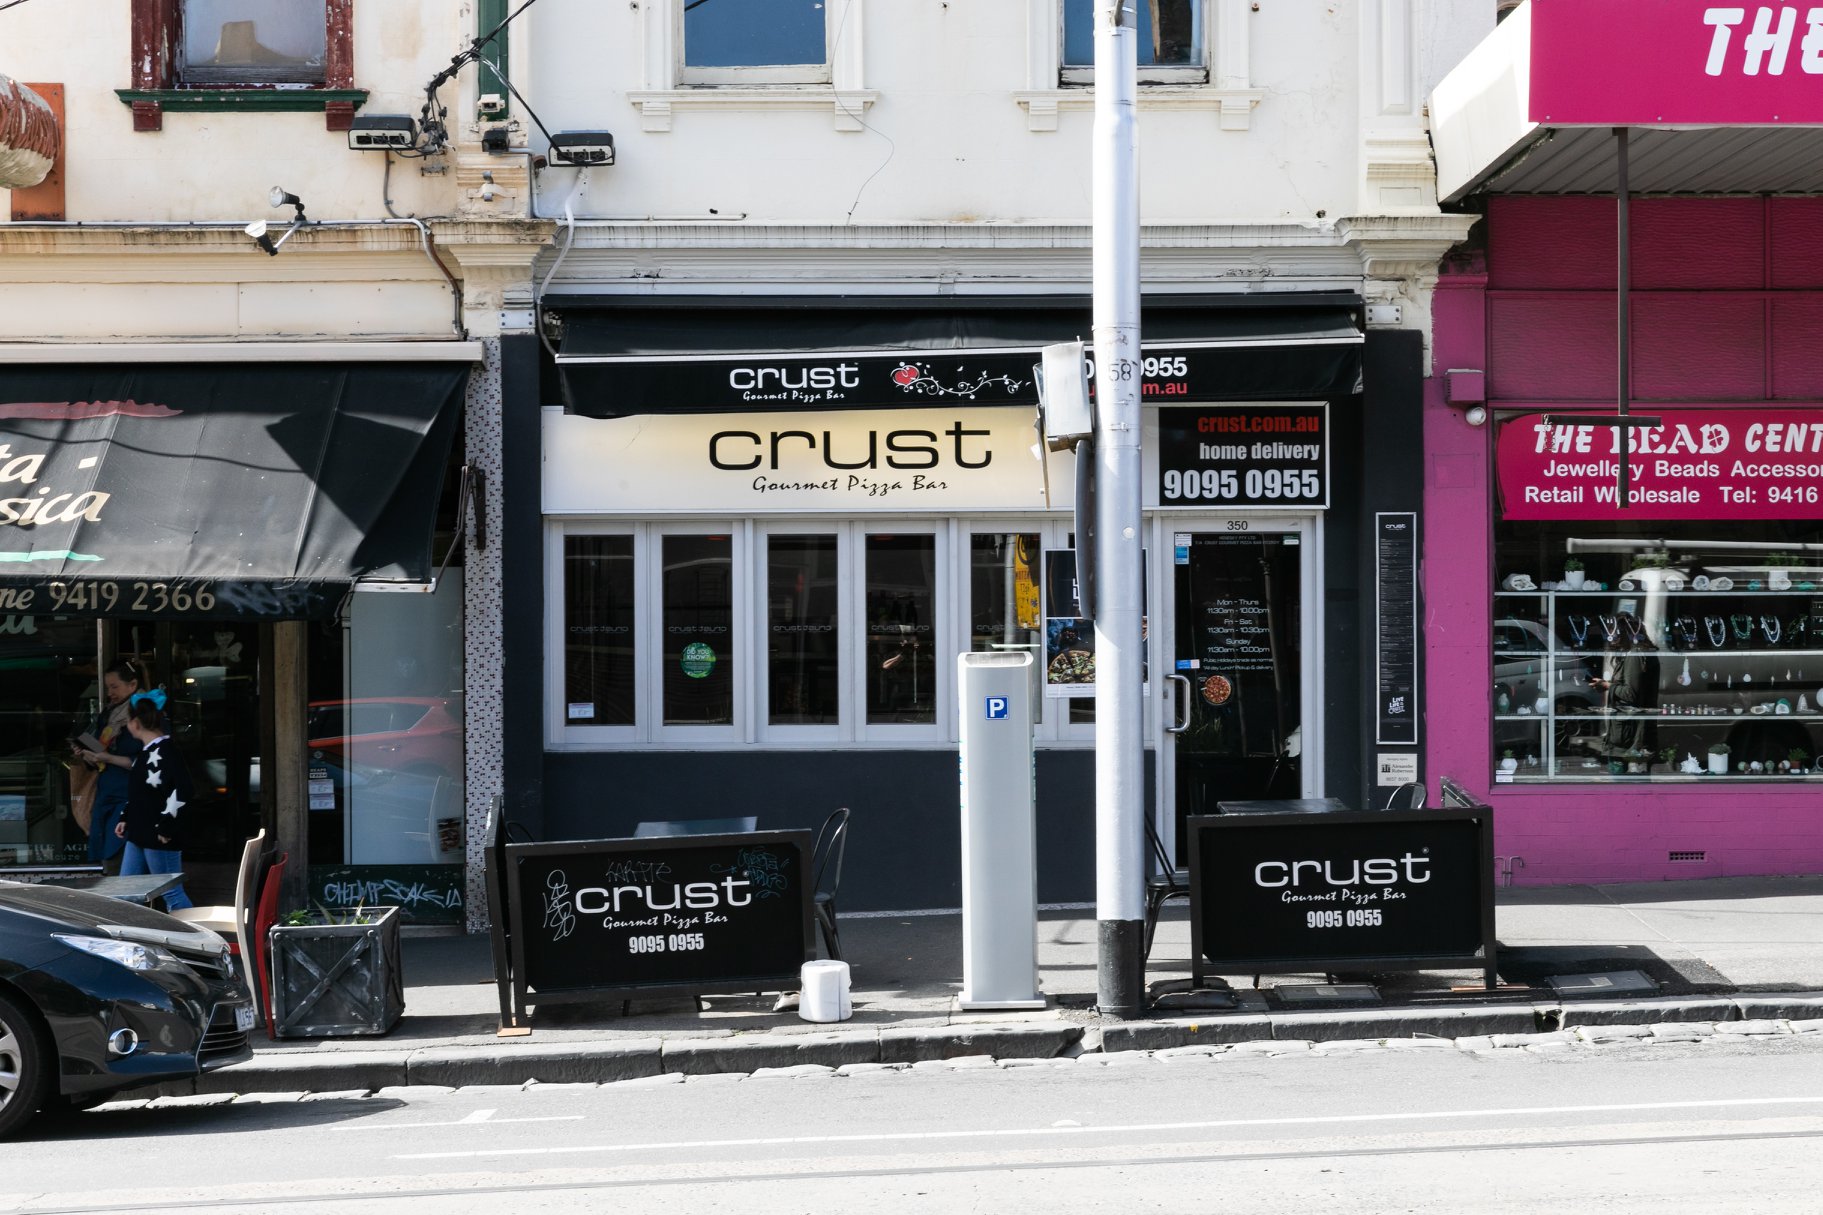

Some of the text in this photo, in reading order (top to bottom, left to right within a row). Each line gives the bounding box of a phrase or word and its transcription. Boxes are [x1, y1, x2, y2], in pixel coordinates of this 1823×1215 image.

[1703, 7, 1823, 76] THE
[729, 363, 859, 389] crust
[1109, 362, 1131, 382] 58
[1140, 357, 1187, 378] 955
[743, 390, 845, 402] Gourmet Pizza Bar
[1197, 414, 1319, 433] crust.com.au
[708, 421, 992, 470] crust
[1533, 424, 1594, 453] THE
[1609, 423, 1730, 454] BEAD
[1199, 442, 1320, 461] home delivery
[1543, 460, 1644, 481] Jewelley
[1655, 460, 1720, 478] Beads
[752, 474, 949, 496] Gourmet Pizza Bar
[1163, 469, 1319, 499] 9095 0955
[1525, 486, 1584, 503] Retail
[1719, 486, 1757, 504] Tel:
[1767, 486, 1819, 504] 9416
[1227, 520, 1248, 530] 350
[49, 581, 119, 612] 9419
[131, 581, 215, 612] 2366
[990, 698, 1004, 716] P
[1255, 852, 1430, 888] crust
[575, 876, 751, 914] crust
[1282, 887, 1407, 904] Gourmet Pizza Bar
[603, 911, 728, 930] Gourmet Pizza Bar
[1307, 909, 1382, 928] 9095 0955
[629, 933, 704, 954] 9095 0955
